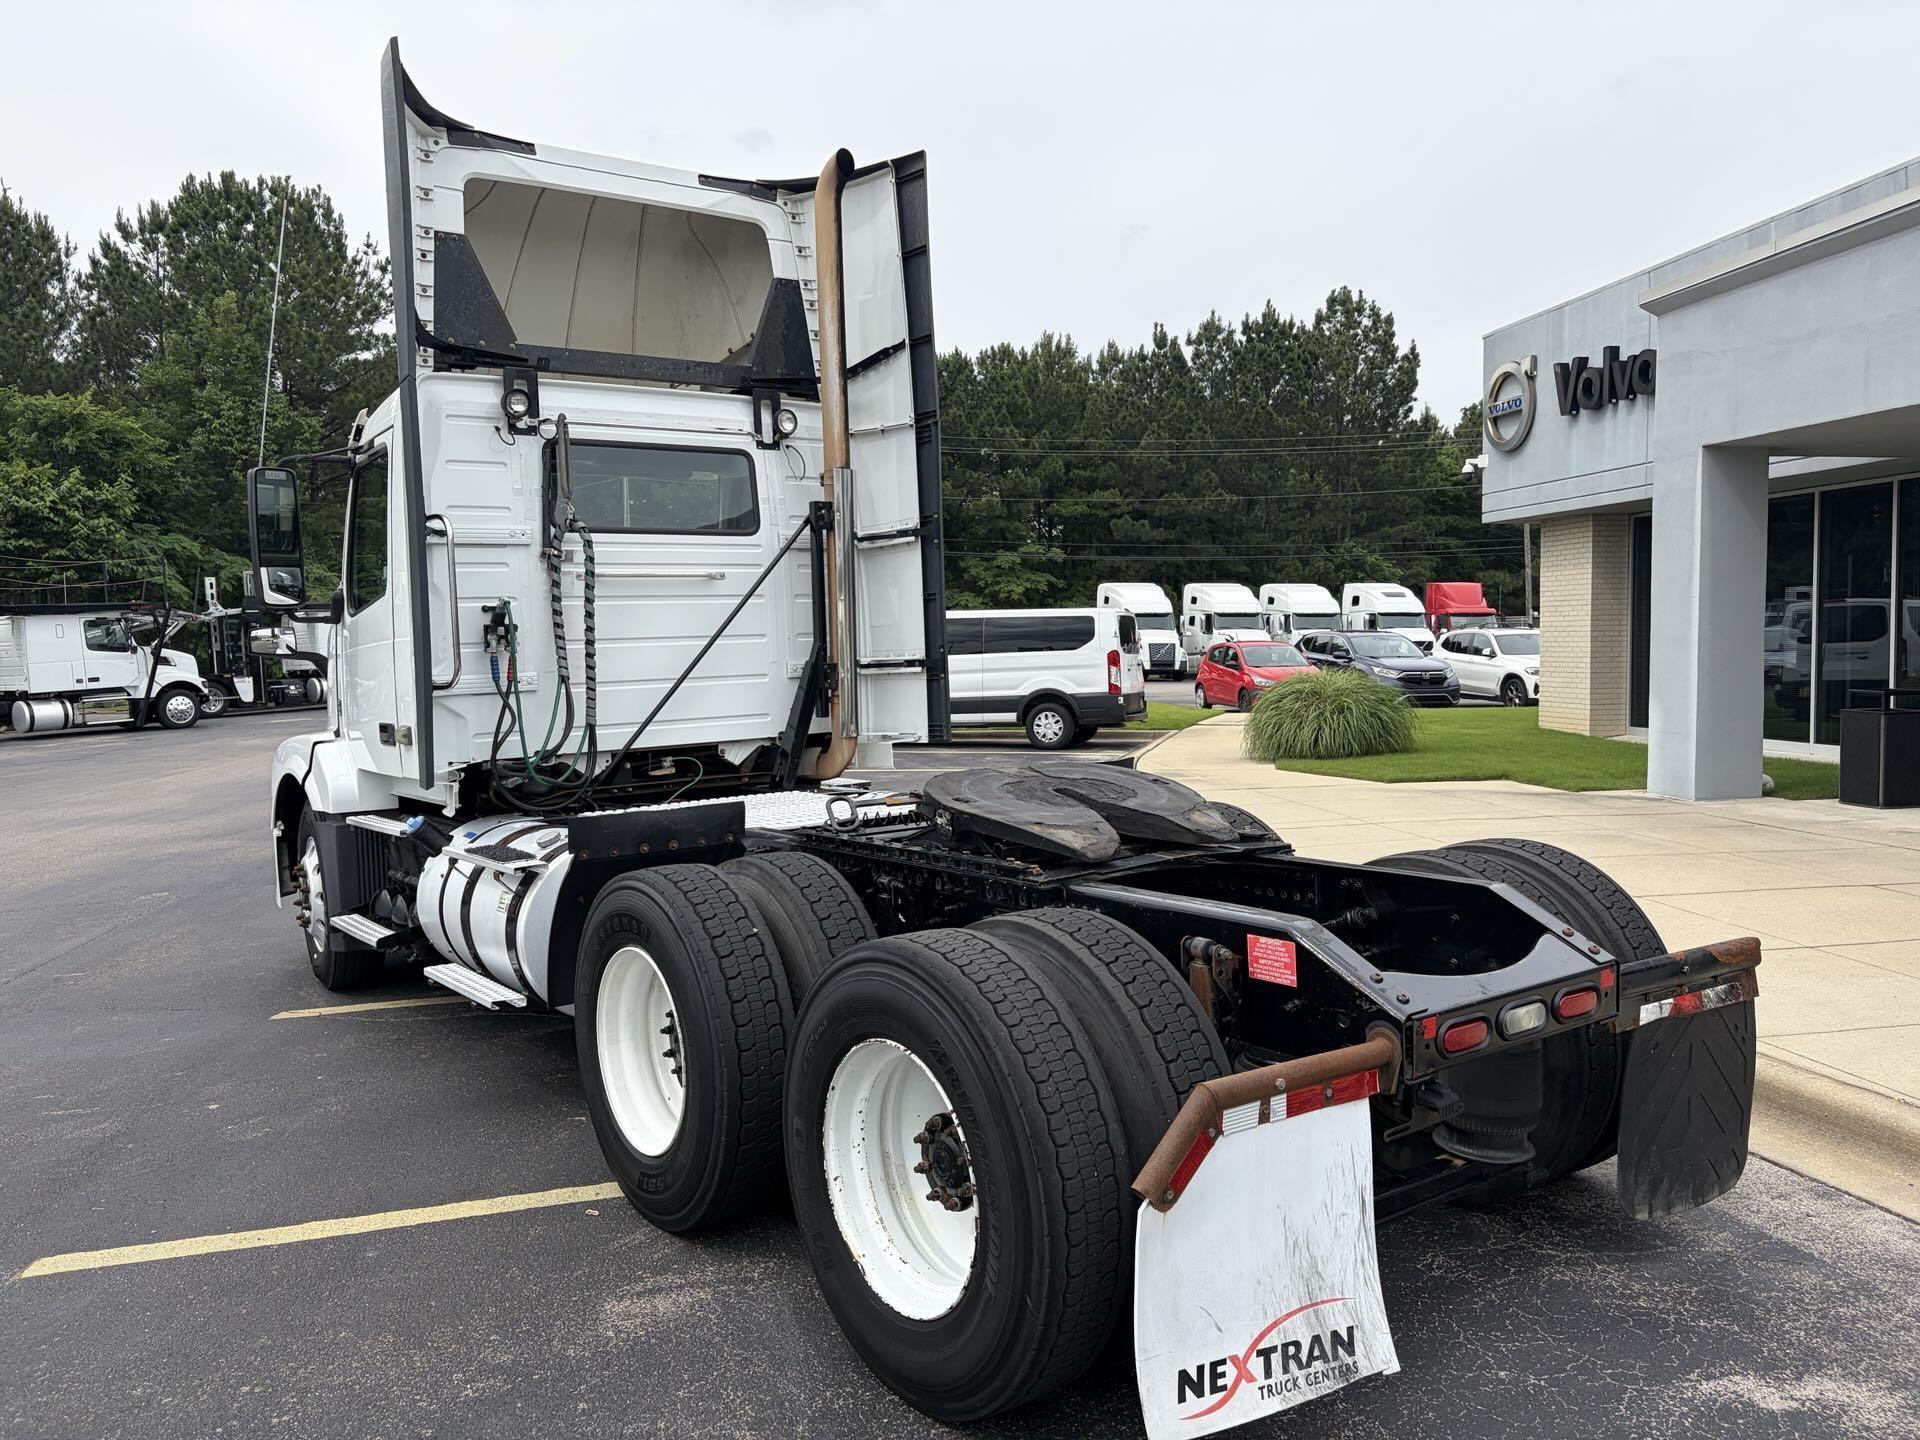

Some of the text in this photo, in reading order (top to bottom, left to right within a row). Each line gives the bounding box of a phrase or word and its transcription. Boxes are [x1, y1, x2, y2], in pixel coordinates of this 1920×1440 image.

[1488, 396, 1523, 415] VOLVO
[1553, 345, 1657, 417] Volvo
[1177, 1326, 1357, 1405] NEXTRAN
[1257, 1360, 1360, 1401] TRUCK CENTERS
